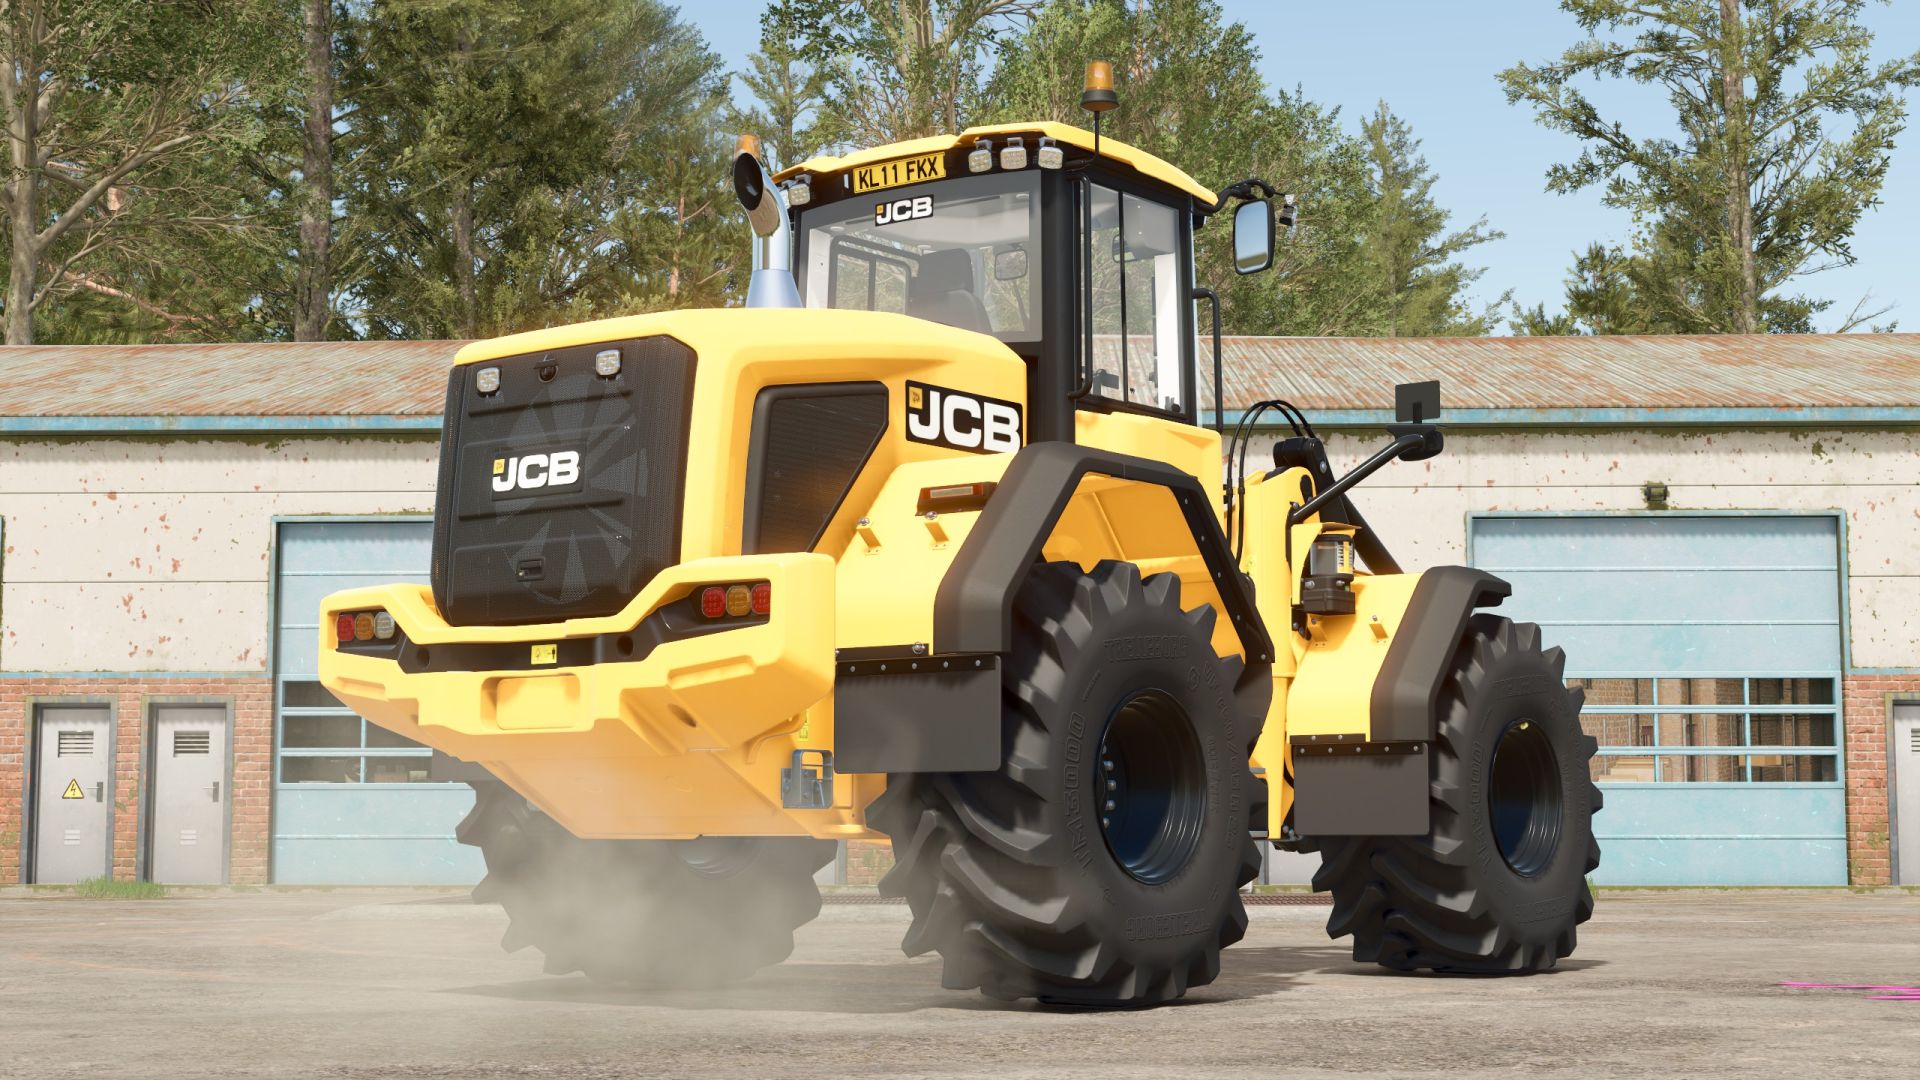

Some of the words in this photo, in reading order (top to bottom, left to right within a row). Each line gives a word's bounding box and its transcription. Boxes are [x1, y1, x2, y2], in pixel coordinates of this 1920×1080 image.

[859, 164, 898, 190] KL11
[906, 156, 938, 181] FKX
[876, 196, 933, 225] JCB
[908, 390, 1021, 454] JCB
[492, 450, 580, 492] JCB
